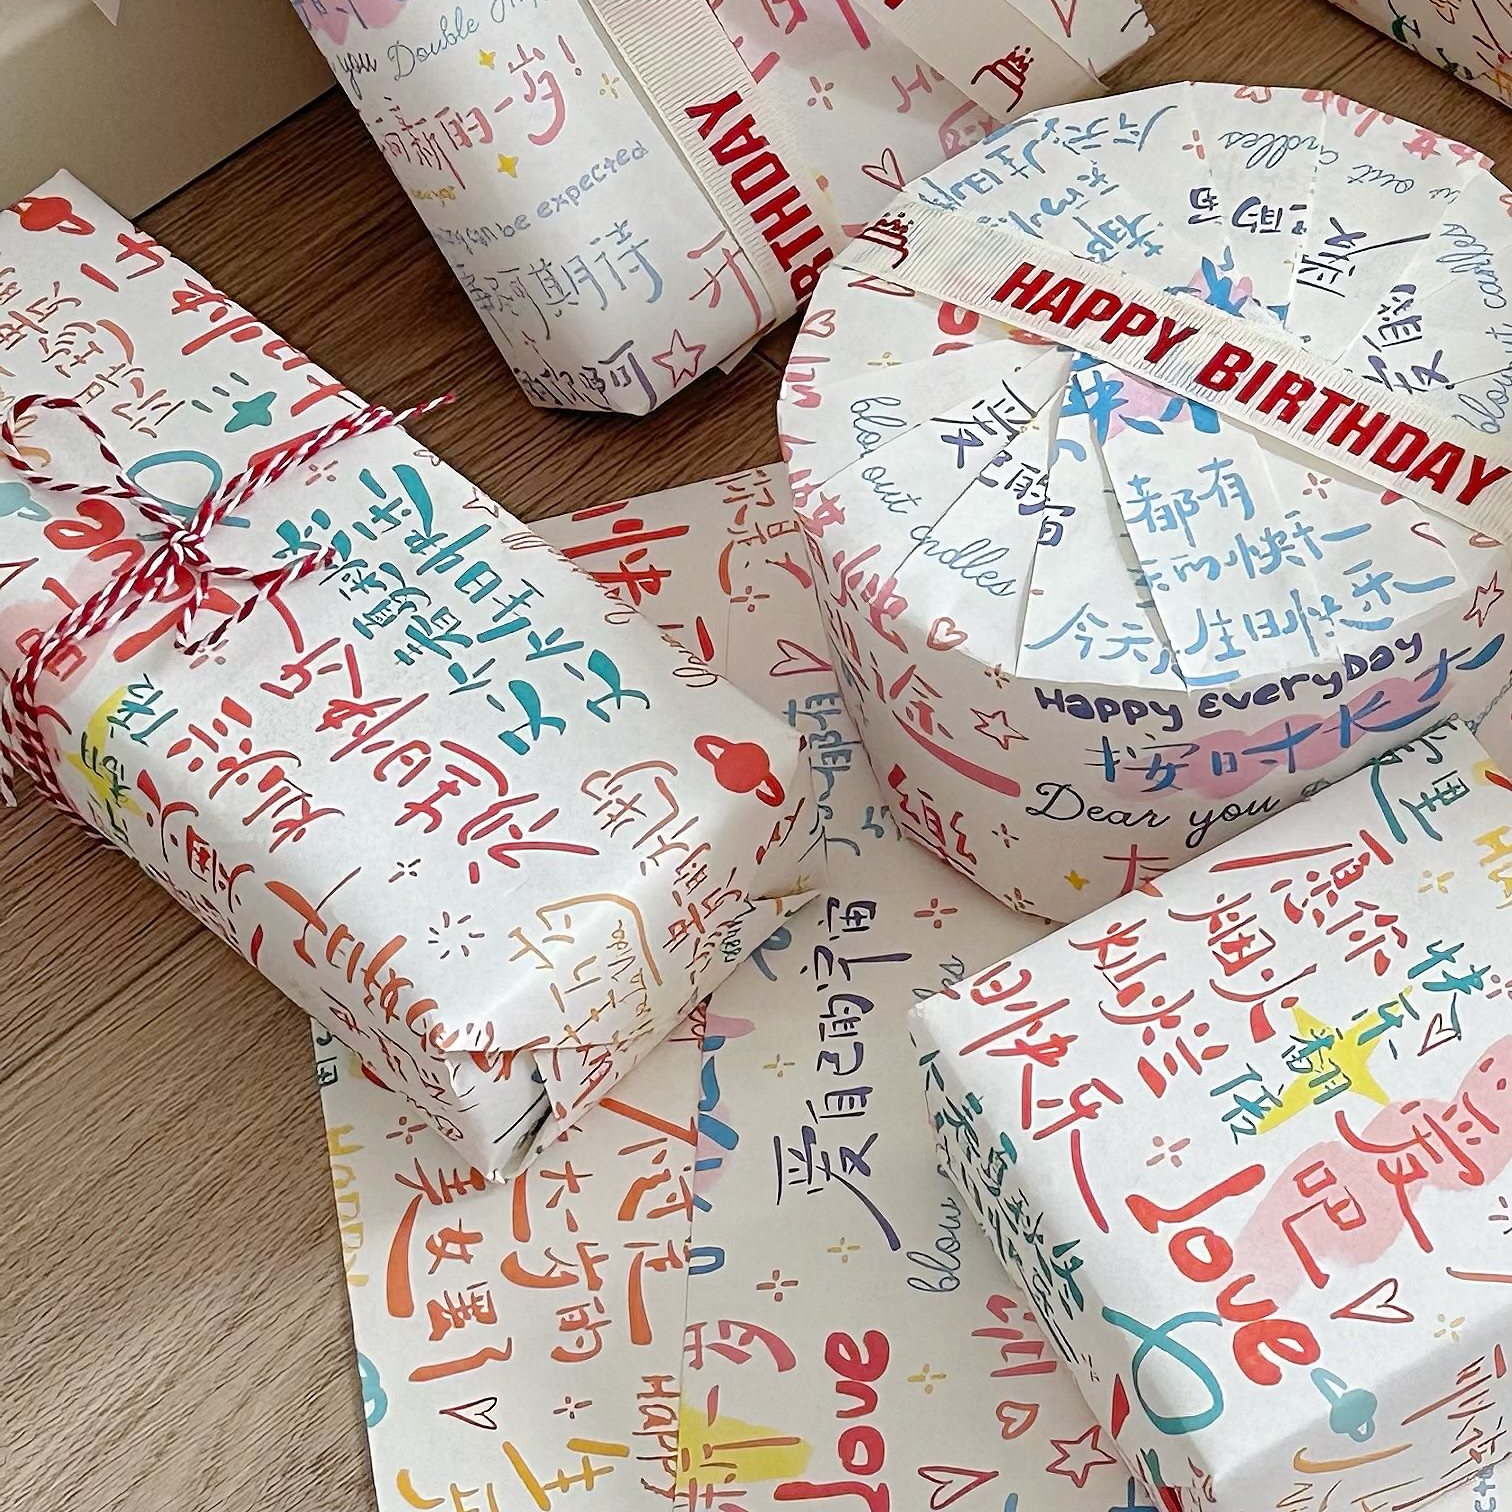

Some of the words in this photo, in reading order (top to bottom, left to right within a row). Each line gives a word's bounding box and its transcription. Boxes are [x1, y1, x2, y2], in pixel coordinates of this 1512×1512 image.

[386, 5, 481, 82] Double
[536, 139, 650, 221] expected
[684, 90, 836, 312] RTHDAY
[990, 261, 1200, 364] HAPPY
[1195, 340, 1512, 507] BIRTHDAY
[1034, 685, 1184, 733] Happy
[1024, 780, 1172, 830] Dear
[1185, 793, 1282, 849] you
[906, 1197, 964, 1294] blow
